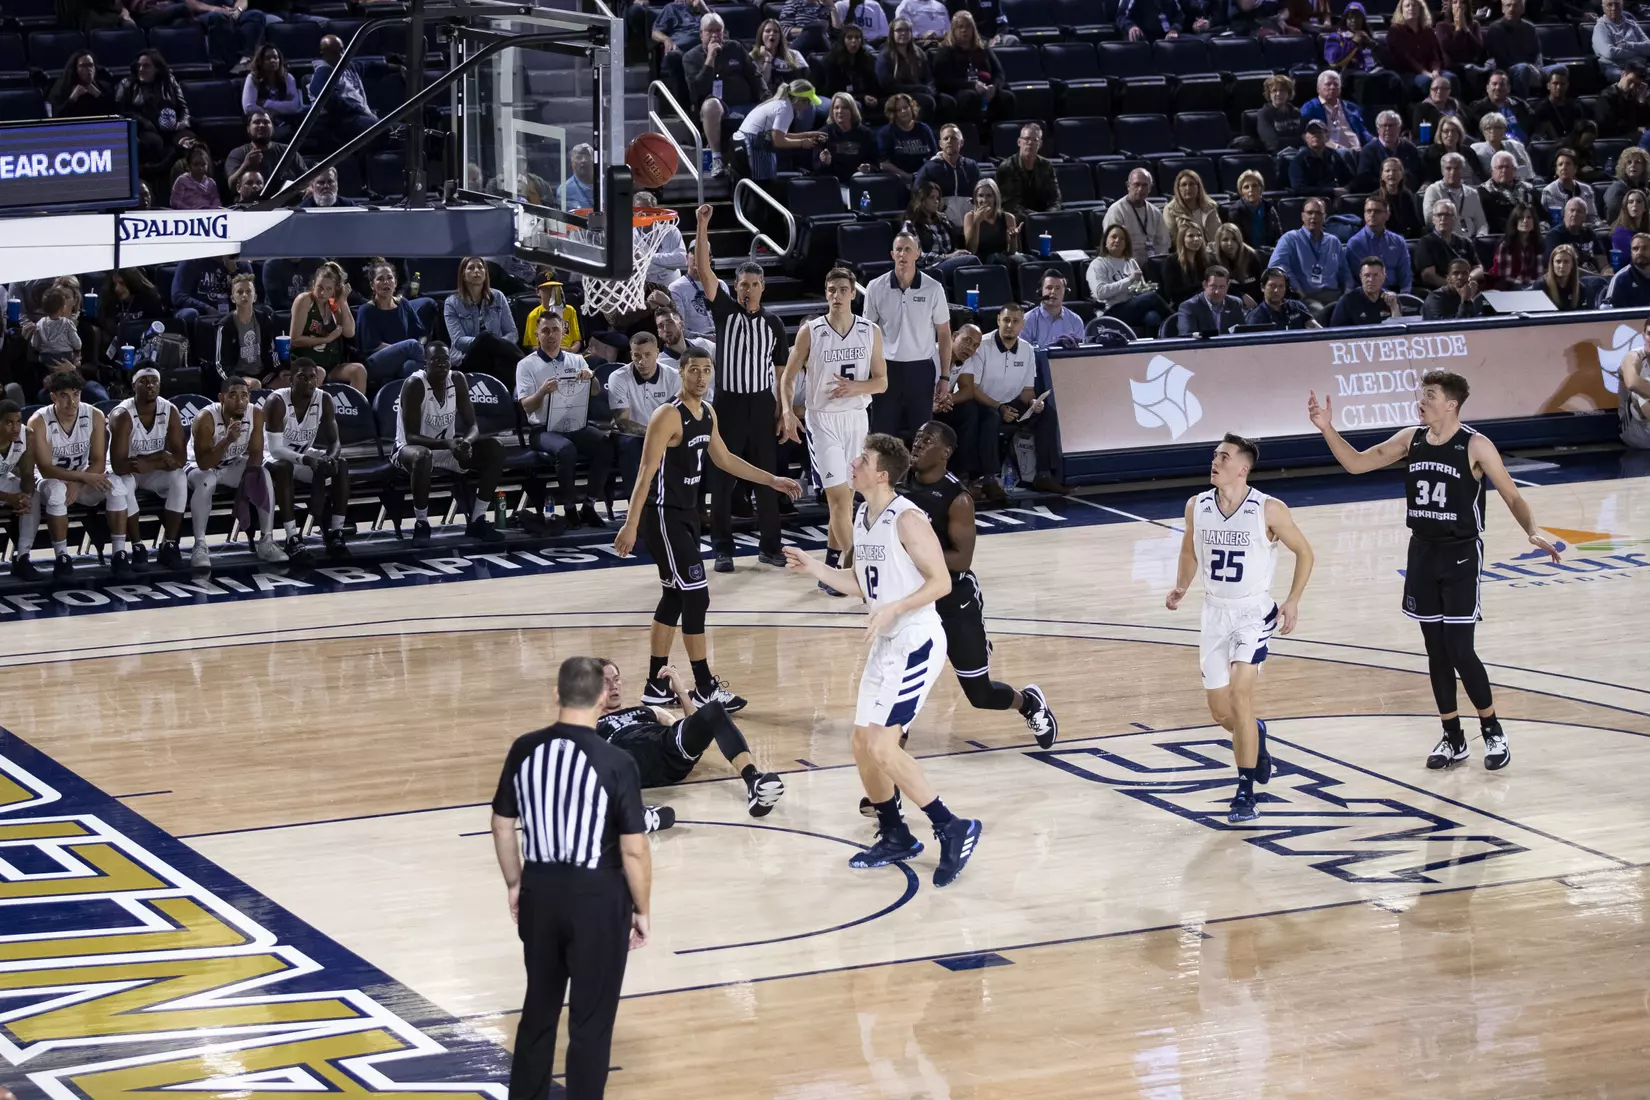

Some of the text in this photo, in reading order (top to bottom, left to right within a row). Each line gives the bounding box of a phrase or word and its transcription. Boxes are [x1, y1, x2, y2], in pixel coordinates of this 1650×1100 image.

[0, 149, 112, 179] EAR.COM
[119, 213, 228, 242] SPALDING
[824, 347, 866, 363] LANCERS
[1329, 335, 1468, 364] RIVERSIDE
[840, 364, 856, 380] 5
[1335, 367, 1445, 397] MEDIC
[334, 405, 358, 415] idas
[469, 395, 498, 405] didas
[1409, 461, 1461, 479] CENTRAL
[1415, 479, 1447, 508] 34
[1408, 508, 1458, 521] ARKANSAS
[1202, 530, 1251, 547] LANCERS
[315, 543, 637, 584] BAPTIST
[1210, 549, 1246, 582] 25
[865, 565, 879, 600] 12
[1508, 572, 1633, 589] CREDIT
